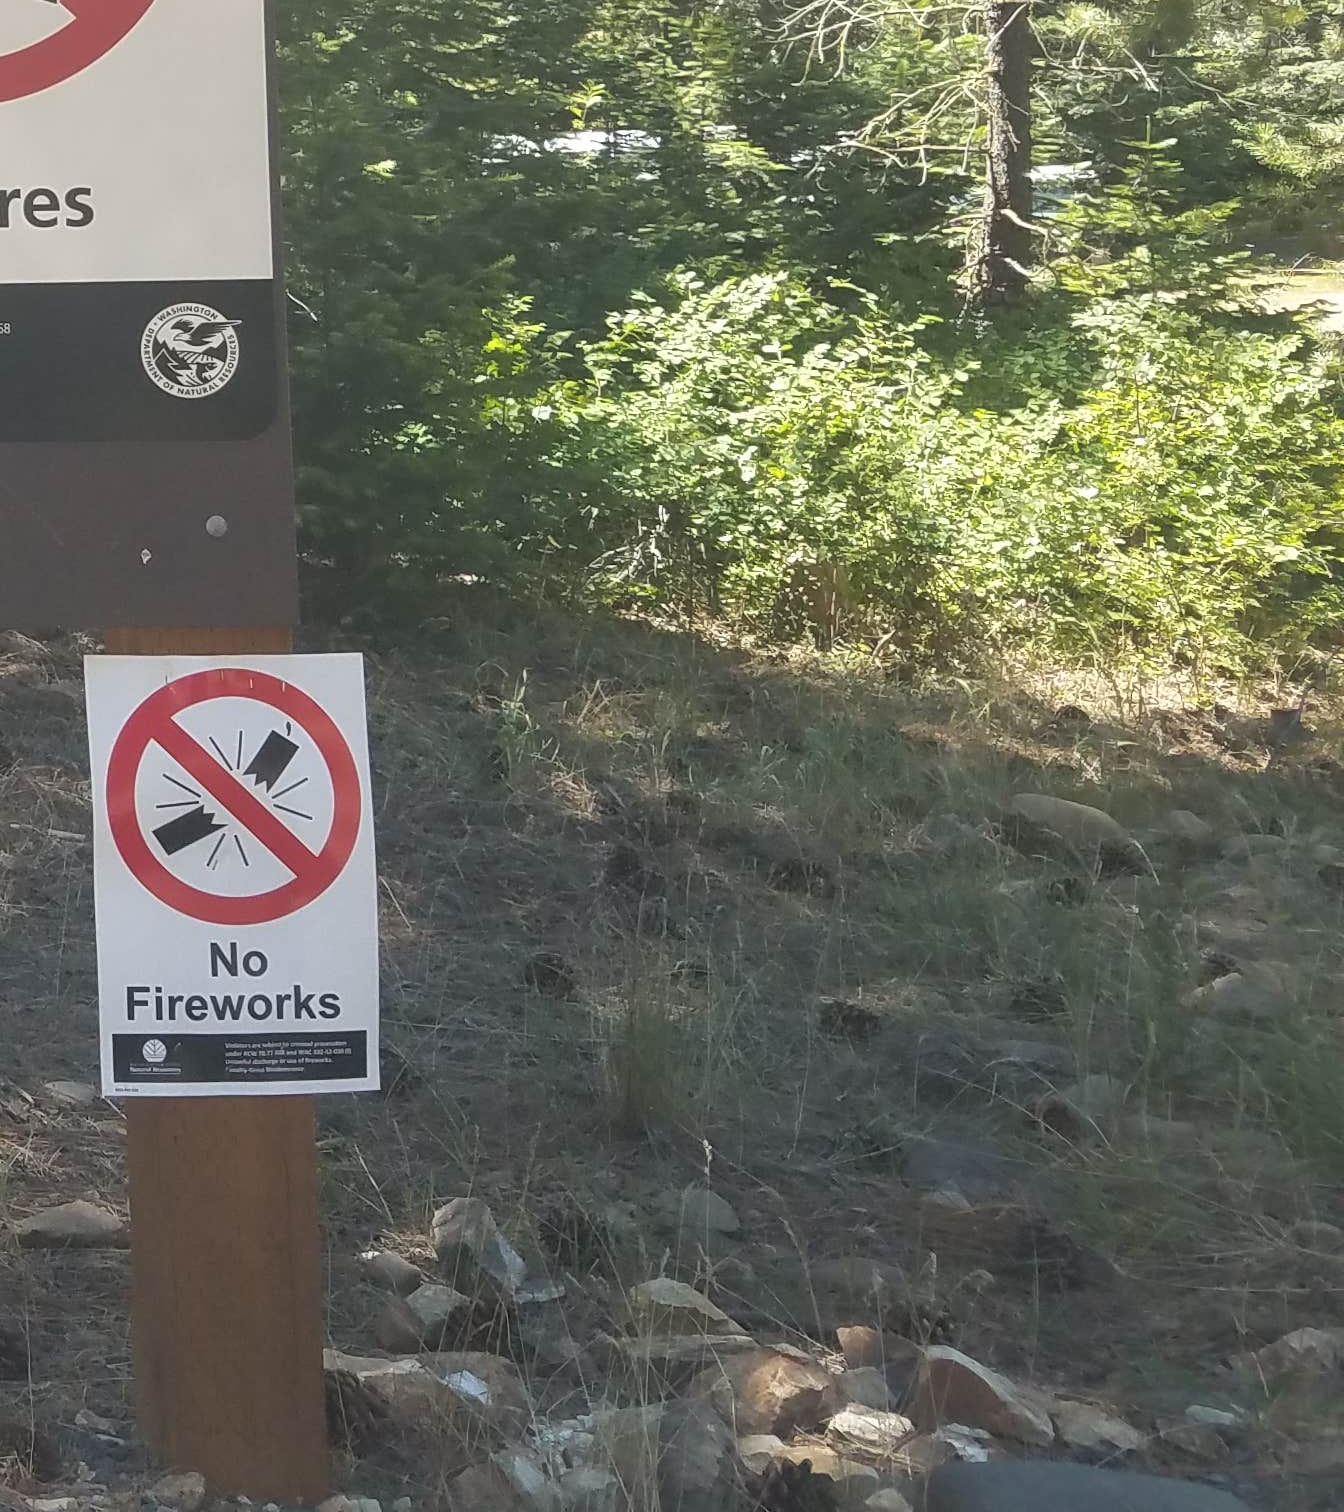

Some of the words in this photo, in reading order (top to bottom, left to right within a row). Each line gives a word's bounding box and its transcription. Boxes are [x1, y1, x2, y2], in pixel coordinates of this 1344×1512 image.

[157, 306, 218, 321] WASHINGTON
[144, 328, 163, 382] DEPARTMENT
[163, 382, 175, 390] OF
[177, 383, 220, 395] NATURAL
[220, 334, 236, 383] RESOURCES
[210, 942, 268, 977] No
[126, 985, 341, 1021] Fireworks
